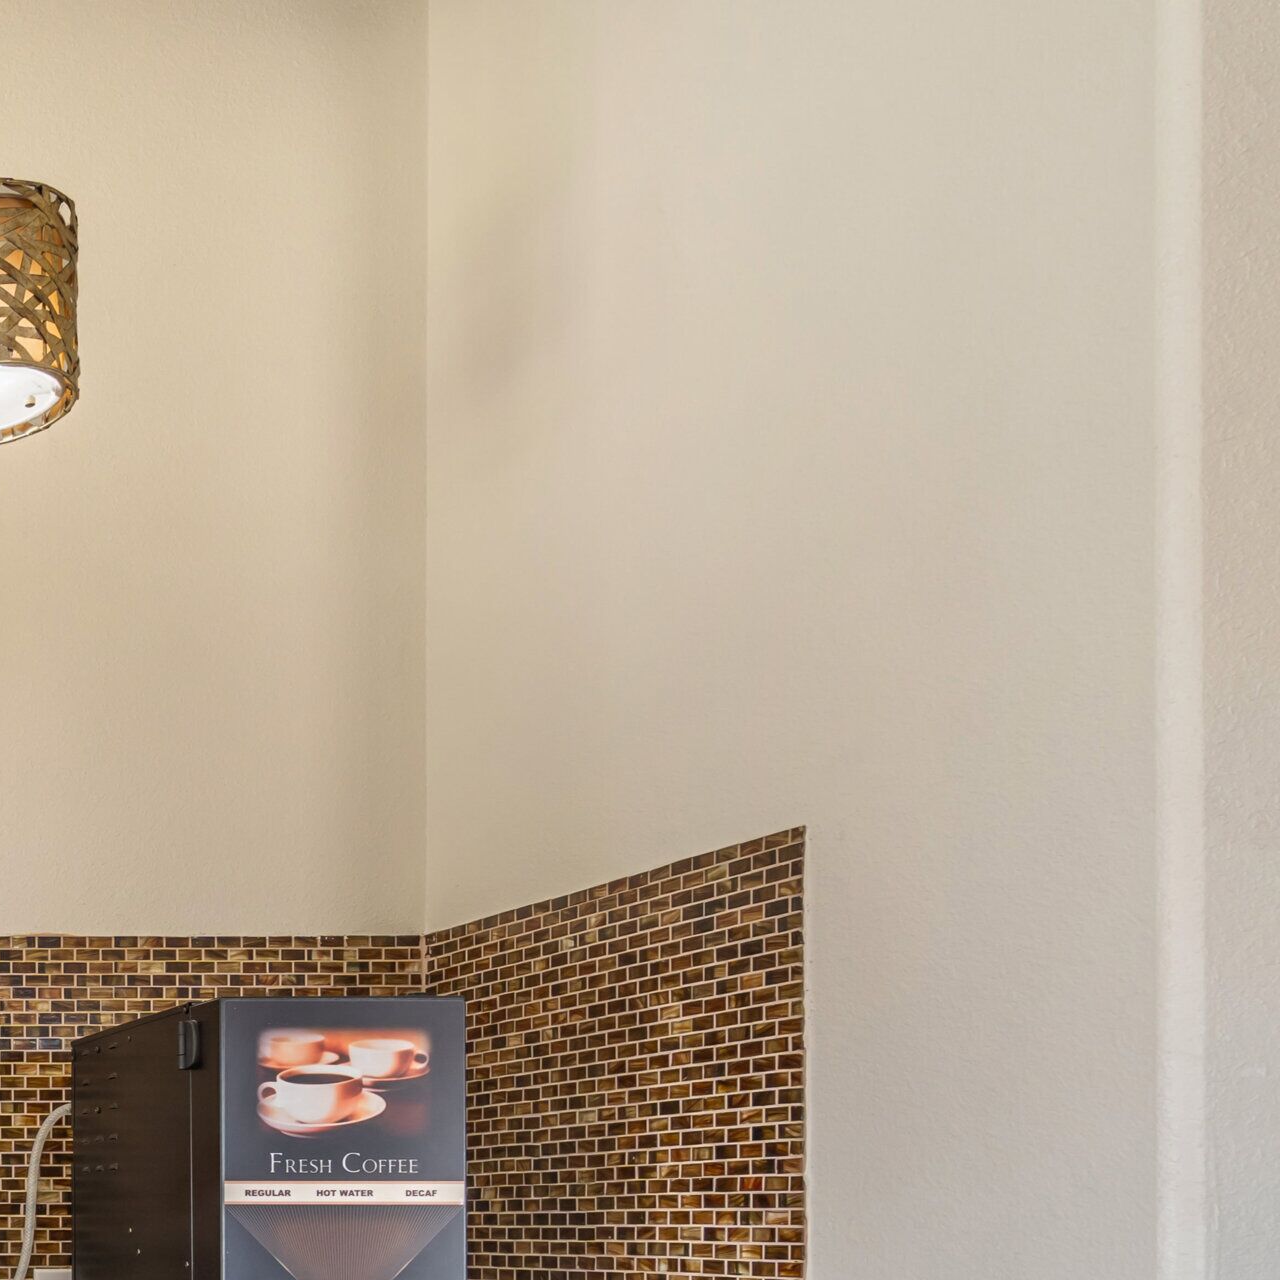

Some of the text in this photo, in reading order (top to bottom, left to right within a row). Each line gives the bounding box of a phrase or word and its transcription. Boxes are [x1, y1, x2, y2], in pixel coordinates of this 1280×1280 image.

[269, 1152, 419, 1174] FRESH COFFEE
[245, 1189, 291, 1197] REGULAR
[316, 1189, 373, 1197] HOT WATER
[405, 1189, 437, 1197] DECAF
